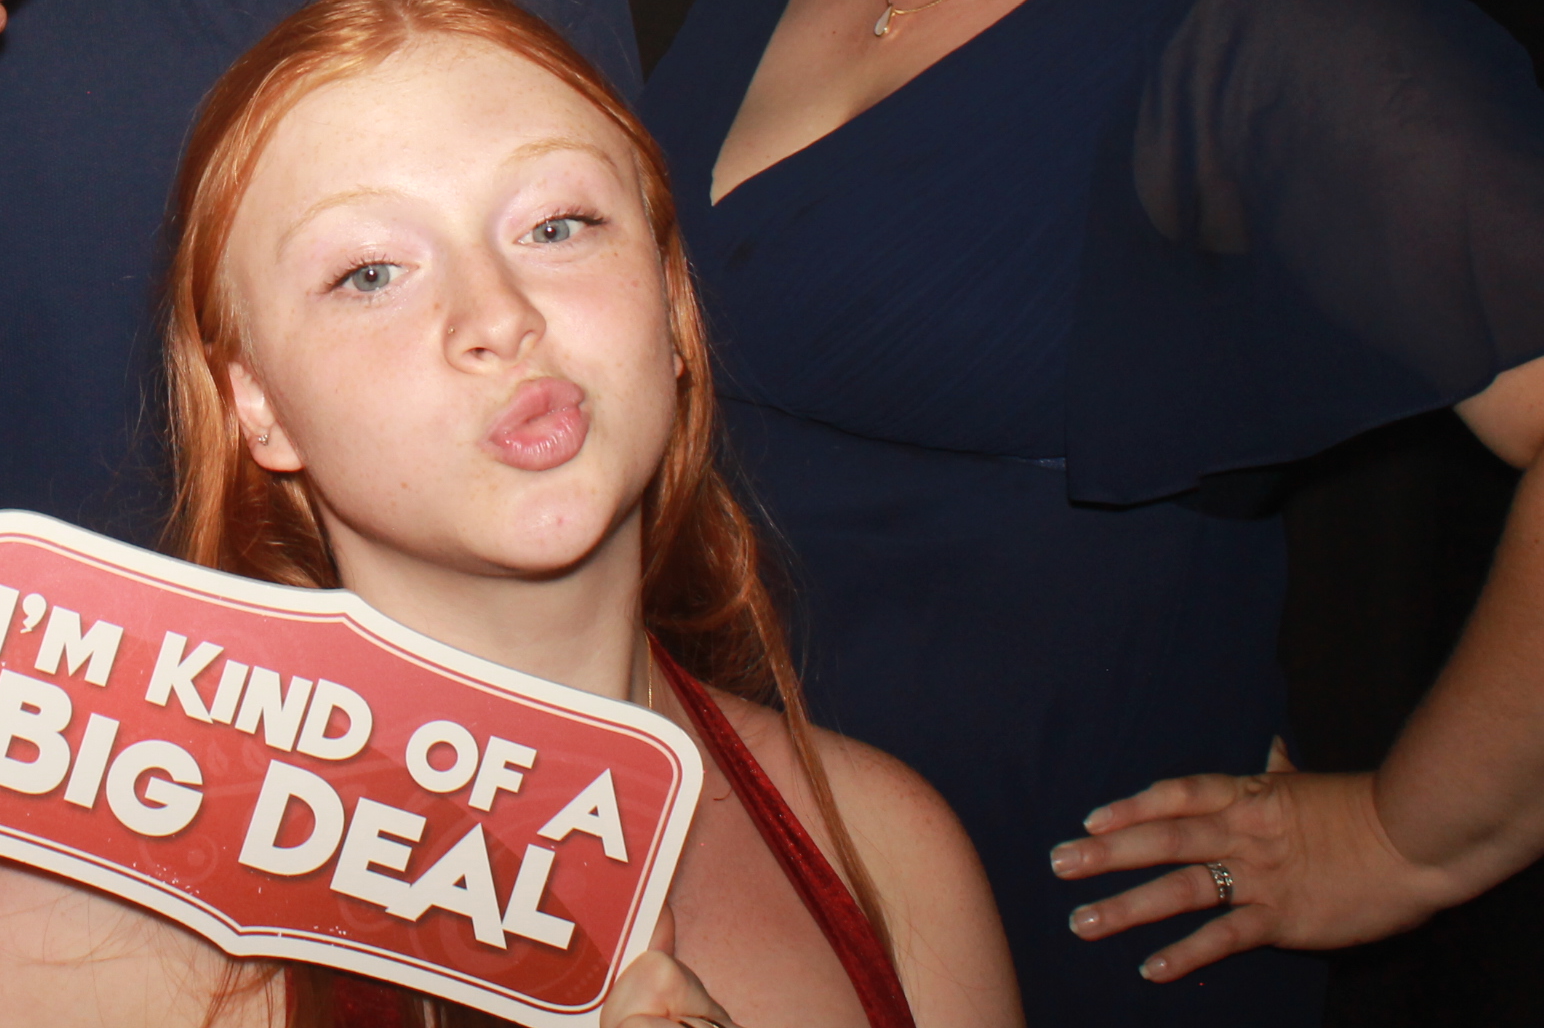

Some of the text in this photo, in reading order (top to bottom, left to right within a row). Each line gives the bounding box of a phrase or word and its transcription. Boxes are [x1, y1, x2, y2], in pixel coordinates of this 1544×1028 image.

[145, 630, 373, 760] KIND
[406, 720, 537, 812] OF
[537, 768, 628, 863] A
[238, 759, 575, 950] DEAL
